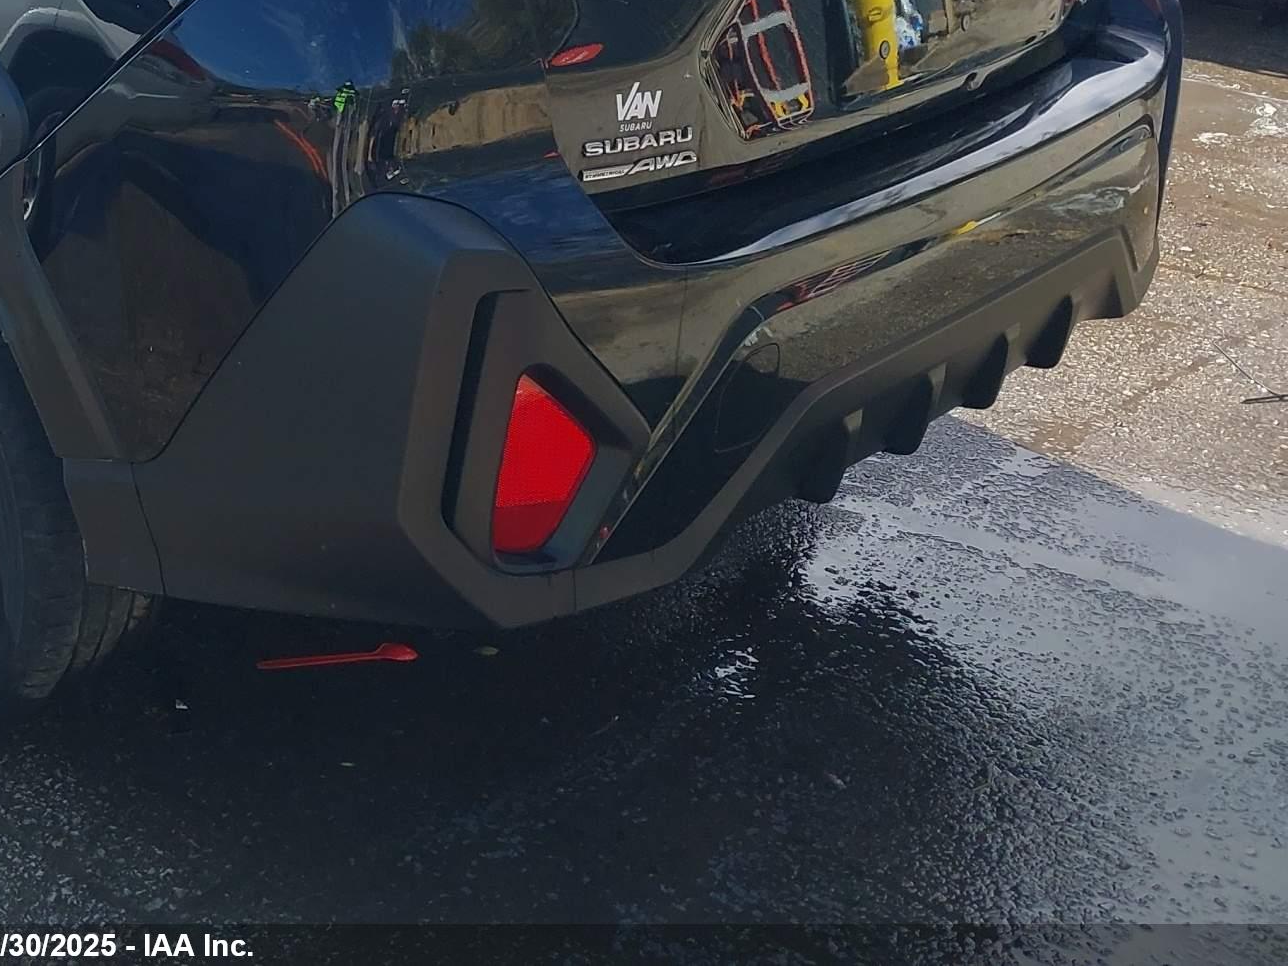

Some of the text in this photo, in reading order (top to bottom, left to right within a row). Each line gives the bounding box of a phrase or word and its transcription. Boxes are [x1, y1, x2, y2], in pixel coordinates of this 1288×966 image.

[616, 81, 663, 121] VAN
[619, 122, 653, 132] SUBARU
[583, 127, 694, 156] SUBARU
[628, 150, 697, 175] AWD
